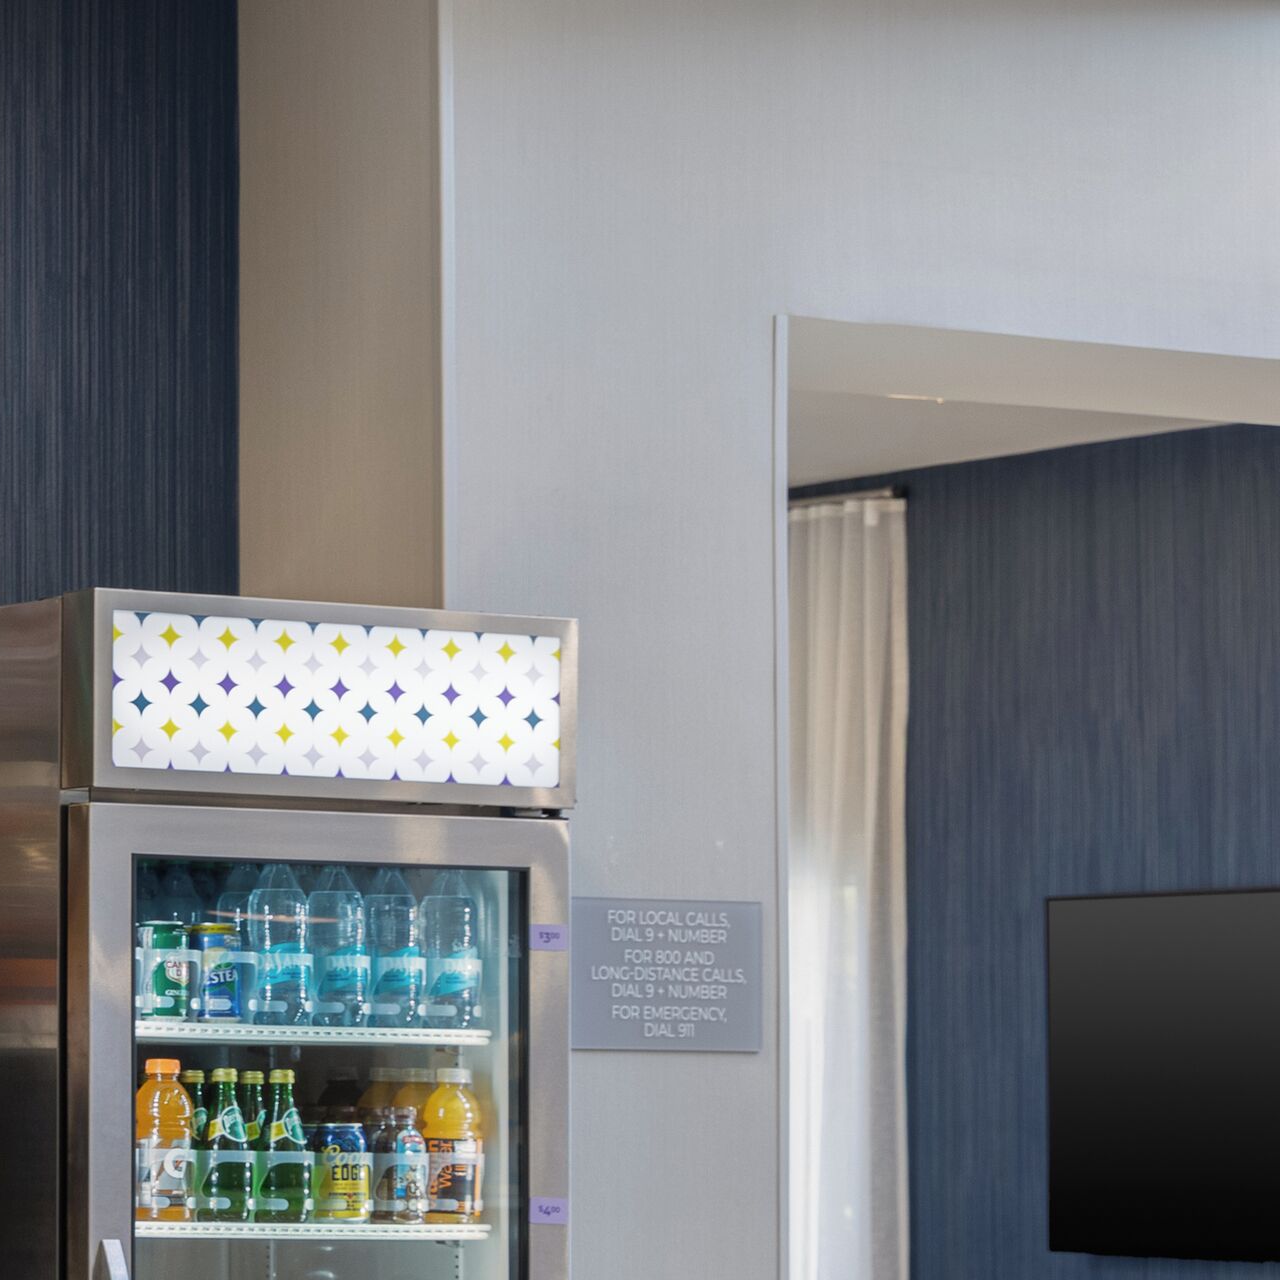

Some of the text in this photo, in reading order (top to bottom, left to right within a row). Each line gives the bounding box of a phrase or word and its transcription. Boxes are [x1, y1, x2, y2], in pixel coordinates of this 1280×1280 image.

[607, 910, 731, 928] FOR LOCAL CALLS,
[611, 928, 643, 942] DIAL
[646, 928, 655, 942] 9
[668, 929, 727, 944] NUMBER
[624, 950, 715, 965] FOR 800 AND
[592, 966, 747, 985] LONG-DISTANCE CALLS,
[611, 983, 643, 998] DIAL
[646, 984, 654, 998] 9
[668, 985, 727, 999] NUMBER
[612, 1005, 728, 1023] FOR EMERGENCY,
[644, 1023, 695, 1038] DIAL 911
